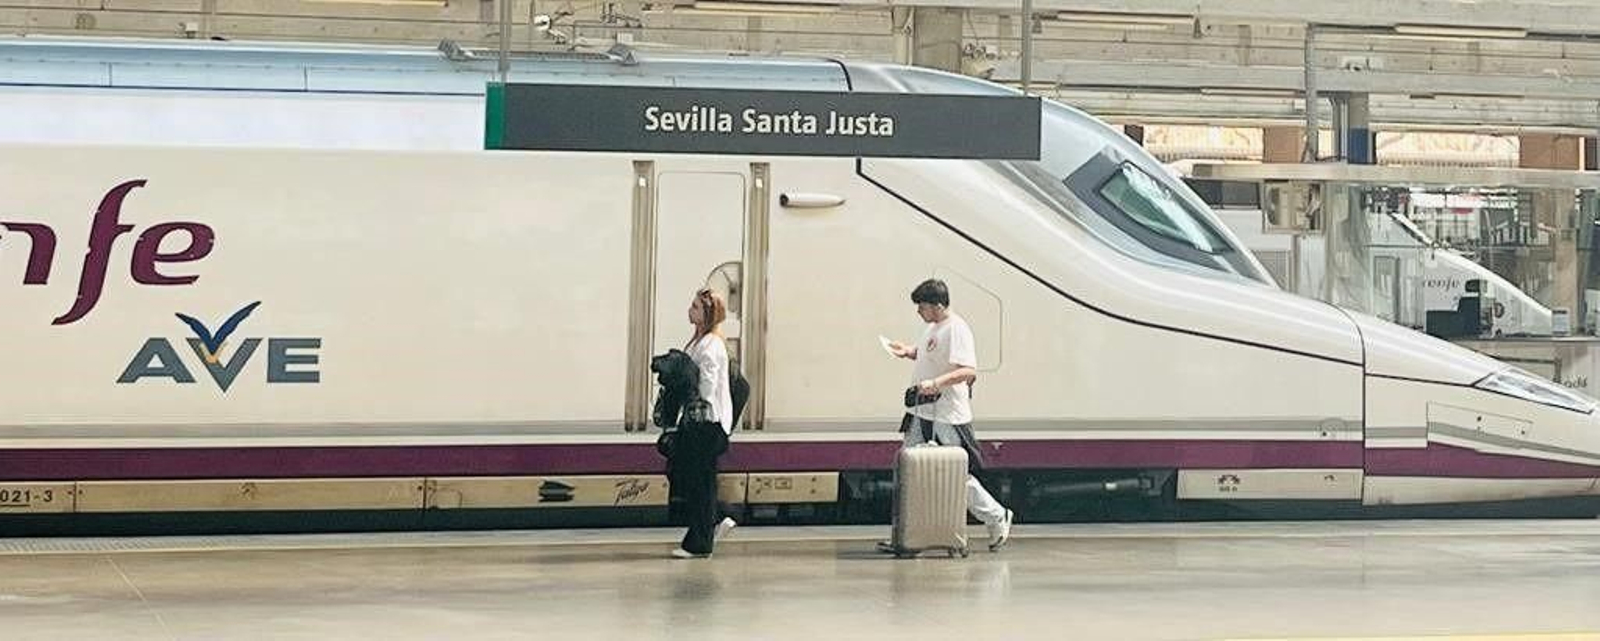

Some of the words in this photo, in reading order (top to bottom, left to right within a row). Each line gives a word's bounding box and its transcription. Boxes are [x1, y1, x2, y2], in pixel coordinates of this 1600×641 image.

[644, 105, 733, 133] Sevilla
[741, 108, 818, 135] Santa
[825, 110, 894, 137] Justa
[116, 336, 322, 393] AVE
